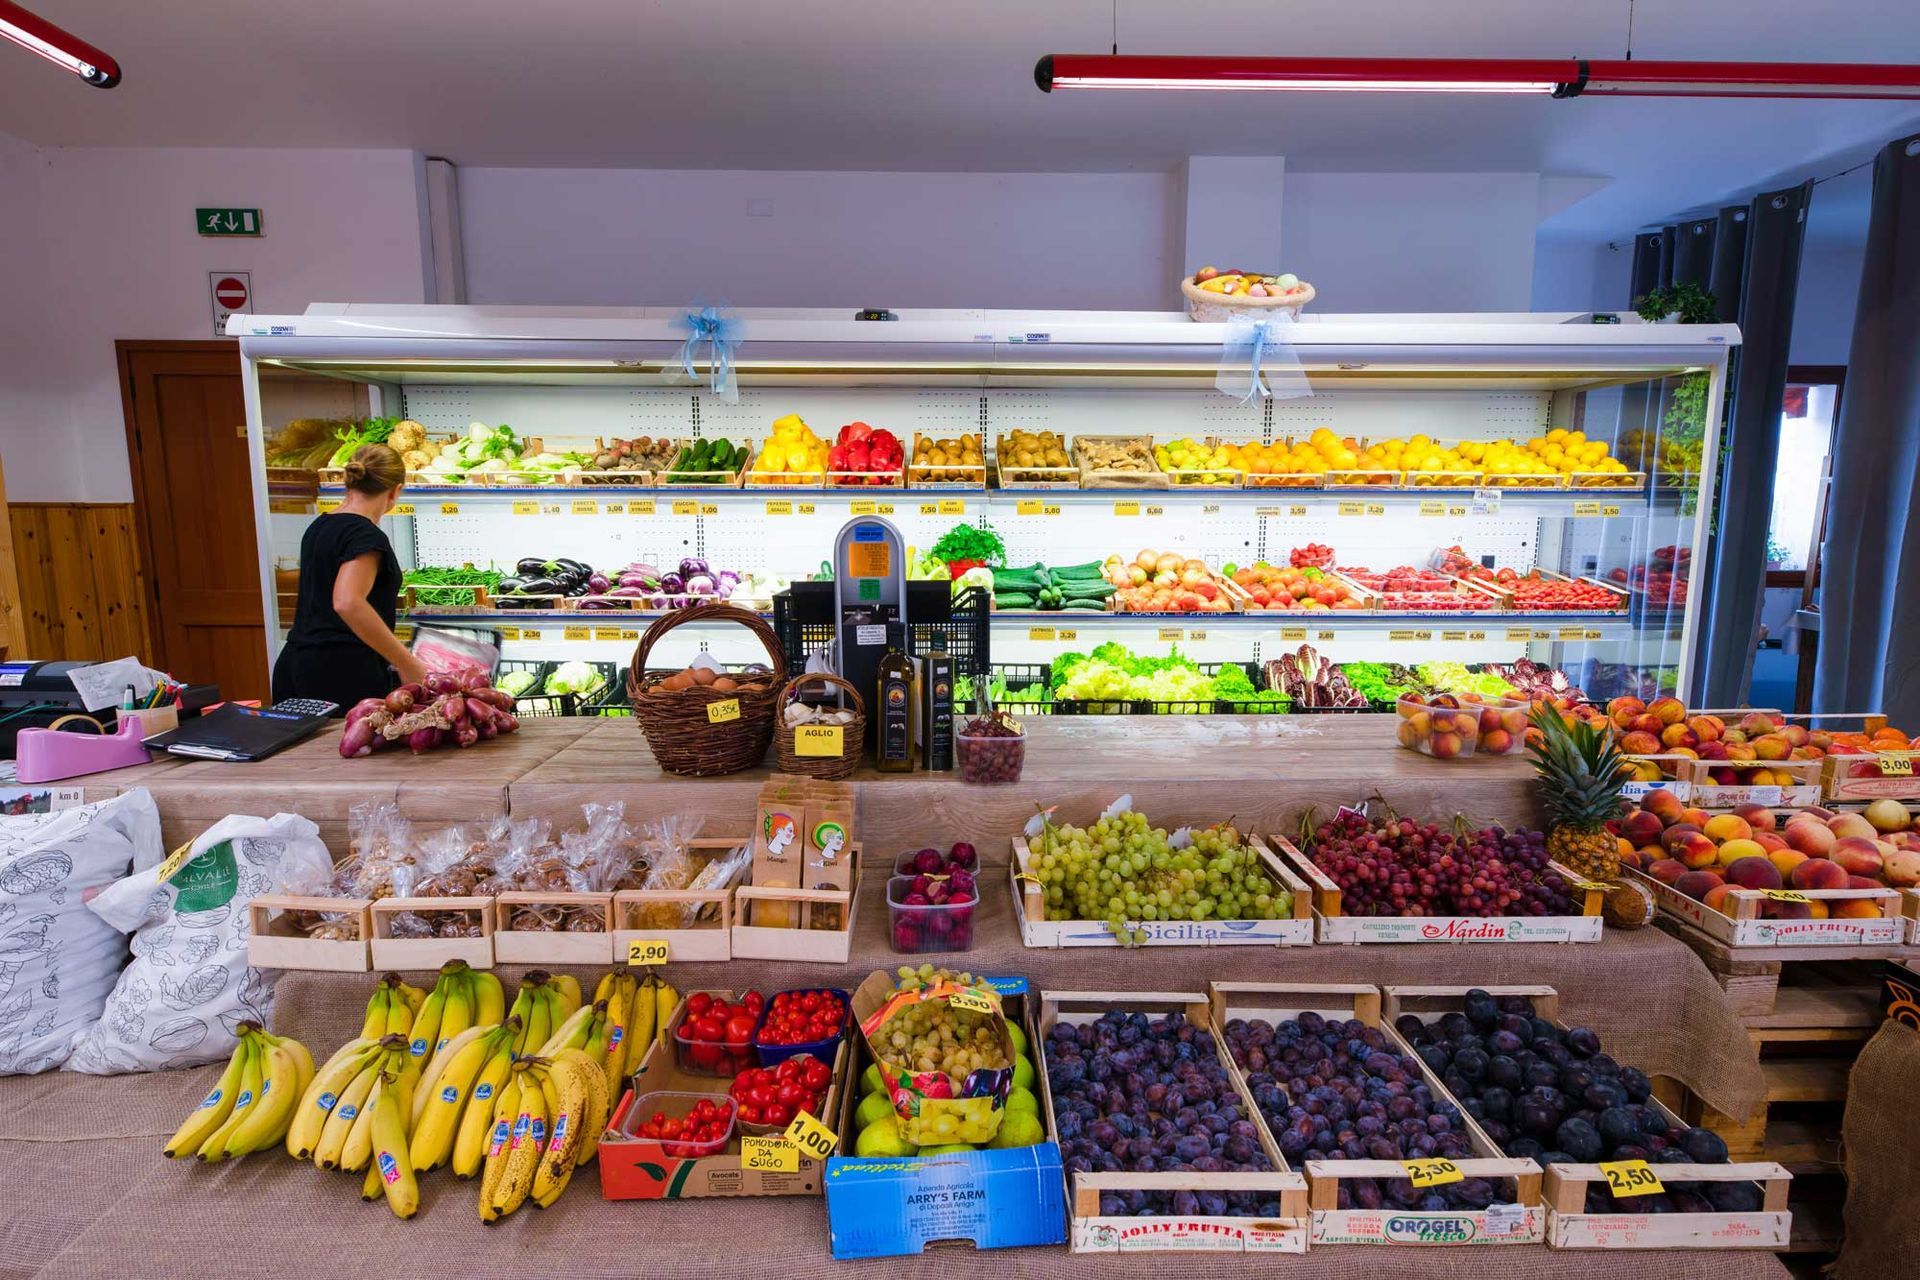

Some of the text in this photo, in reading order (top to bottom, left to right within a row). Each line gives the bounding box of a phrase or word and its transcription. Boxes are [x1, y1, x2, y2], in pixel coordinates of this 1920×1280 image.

[920, 506, 937, 514] 7,50
[804, 729, 834, 738] AGLIO
[1881, 760, 1910, 772] 3,00
[59, 791, 71, 800] km
[1138, 923, 1218, 940] Sicilia
[1422, 919, 1505, 940] Nardin
[1777, 923, 1814, 936] JOLLY
[1819, 924, 1865, 935] FRUTTA
[630, 946, 667, 961] 2,90
[791, 1118, 832, 1156] 1,00
[757, 1149, 773, 1158] DA
[749, 1157, 783, 1169] SUGO
[711, 1171, 740, 1179] Avocats
[1407, 1162, 1456, 1181] 2,30
[1606, 1168, 1657, 1190] 2,50
[946, 1181, 974, 1191] Agricola
[907, 1190, 986, 1205] ARRY'S FARM
[1120, 1222, 1243, 1240] JOLLY FRUTTA
[1389, 1219, 1464, 1234] OROGEL
[1417, 1226, 1467, 1243] fresco
